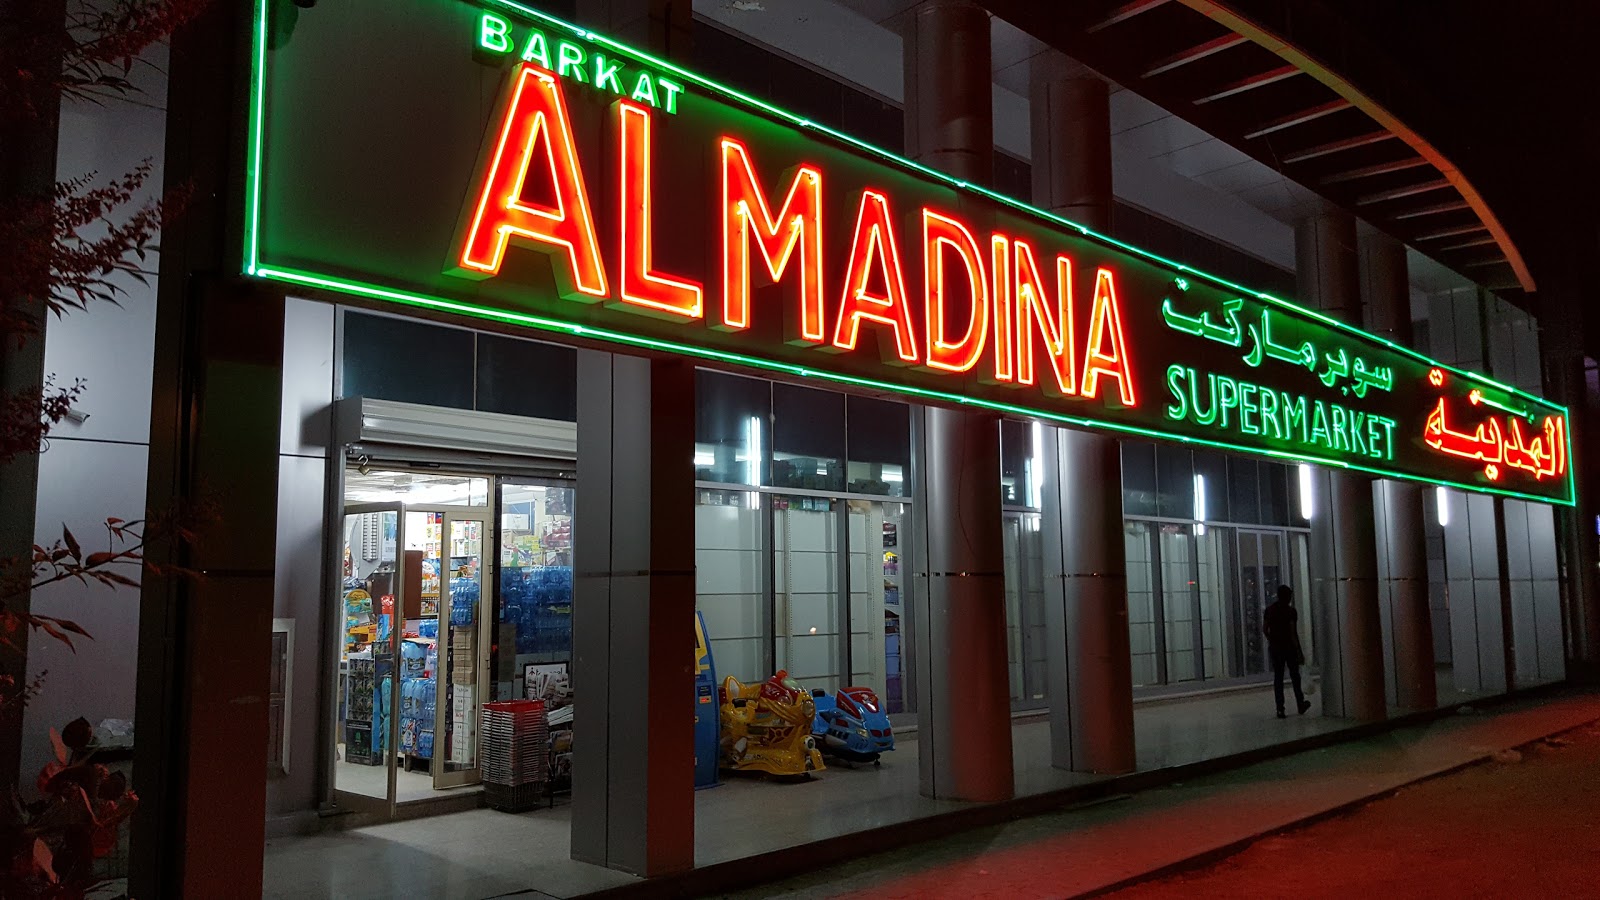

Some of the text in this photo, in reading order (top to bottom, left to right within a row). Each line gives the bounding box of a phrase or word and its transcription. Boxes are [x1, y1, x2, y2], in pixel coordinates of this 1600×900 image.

[479, 9, 684, 114] BARKAT
[456, 61, 1137, 408] ALMADINA
[1166, 363, 1397, 461] SUPERMARKET
[1424, 368, 1566, 482] المدينة
